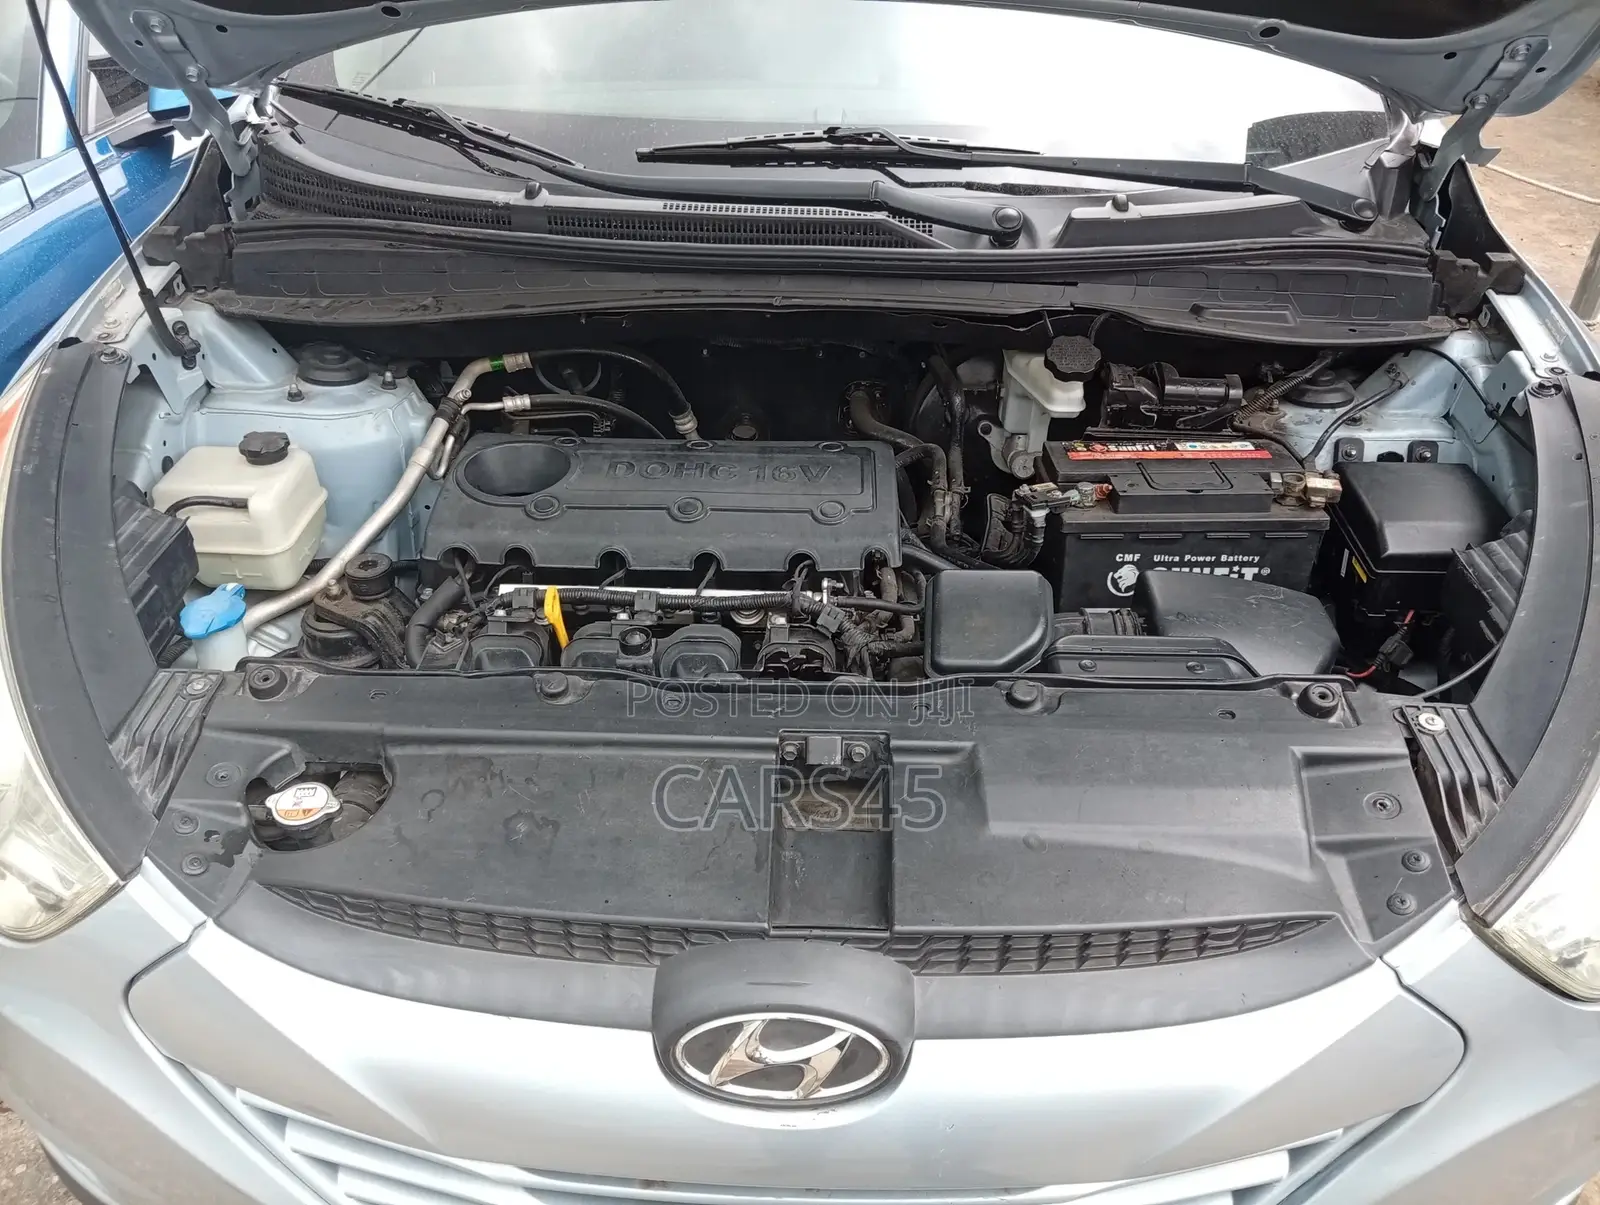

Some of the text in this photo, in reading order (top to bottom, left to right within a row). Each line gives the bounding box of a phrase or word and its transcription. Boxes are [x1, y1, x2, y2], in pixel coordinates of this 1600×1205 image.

[605, 460, 832, 483] DOHC 16V
[1115, 553, 1260, 563] CMF Ultra Power Battery
